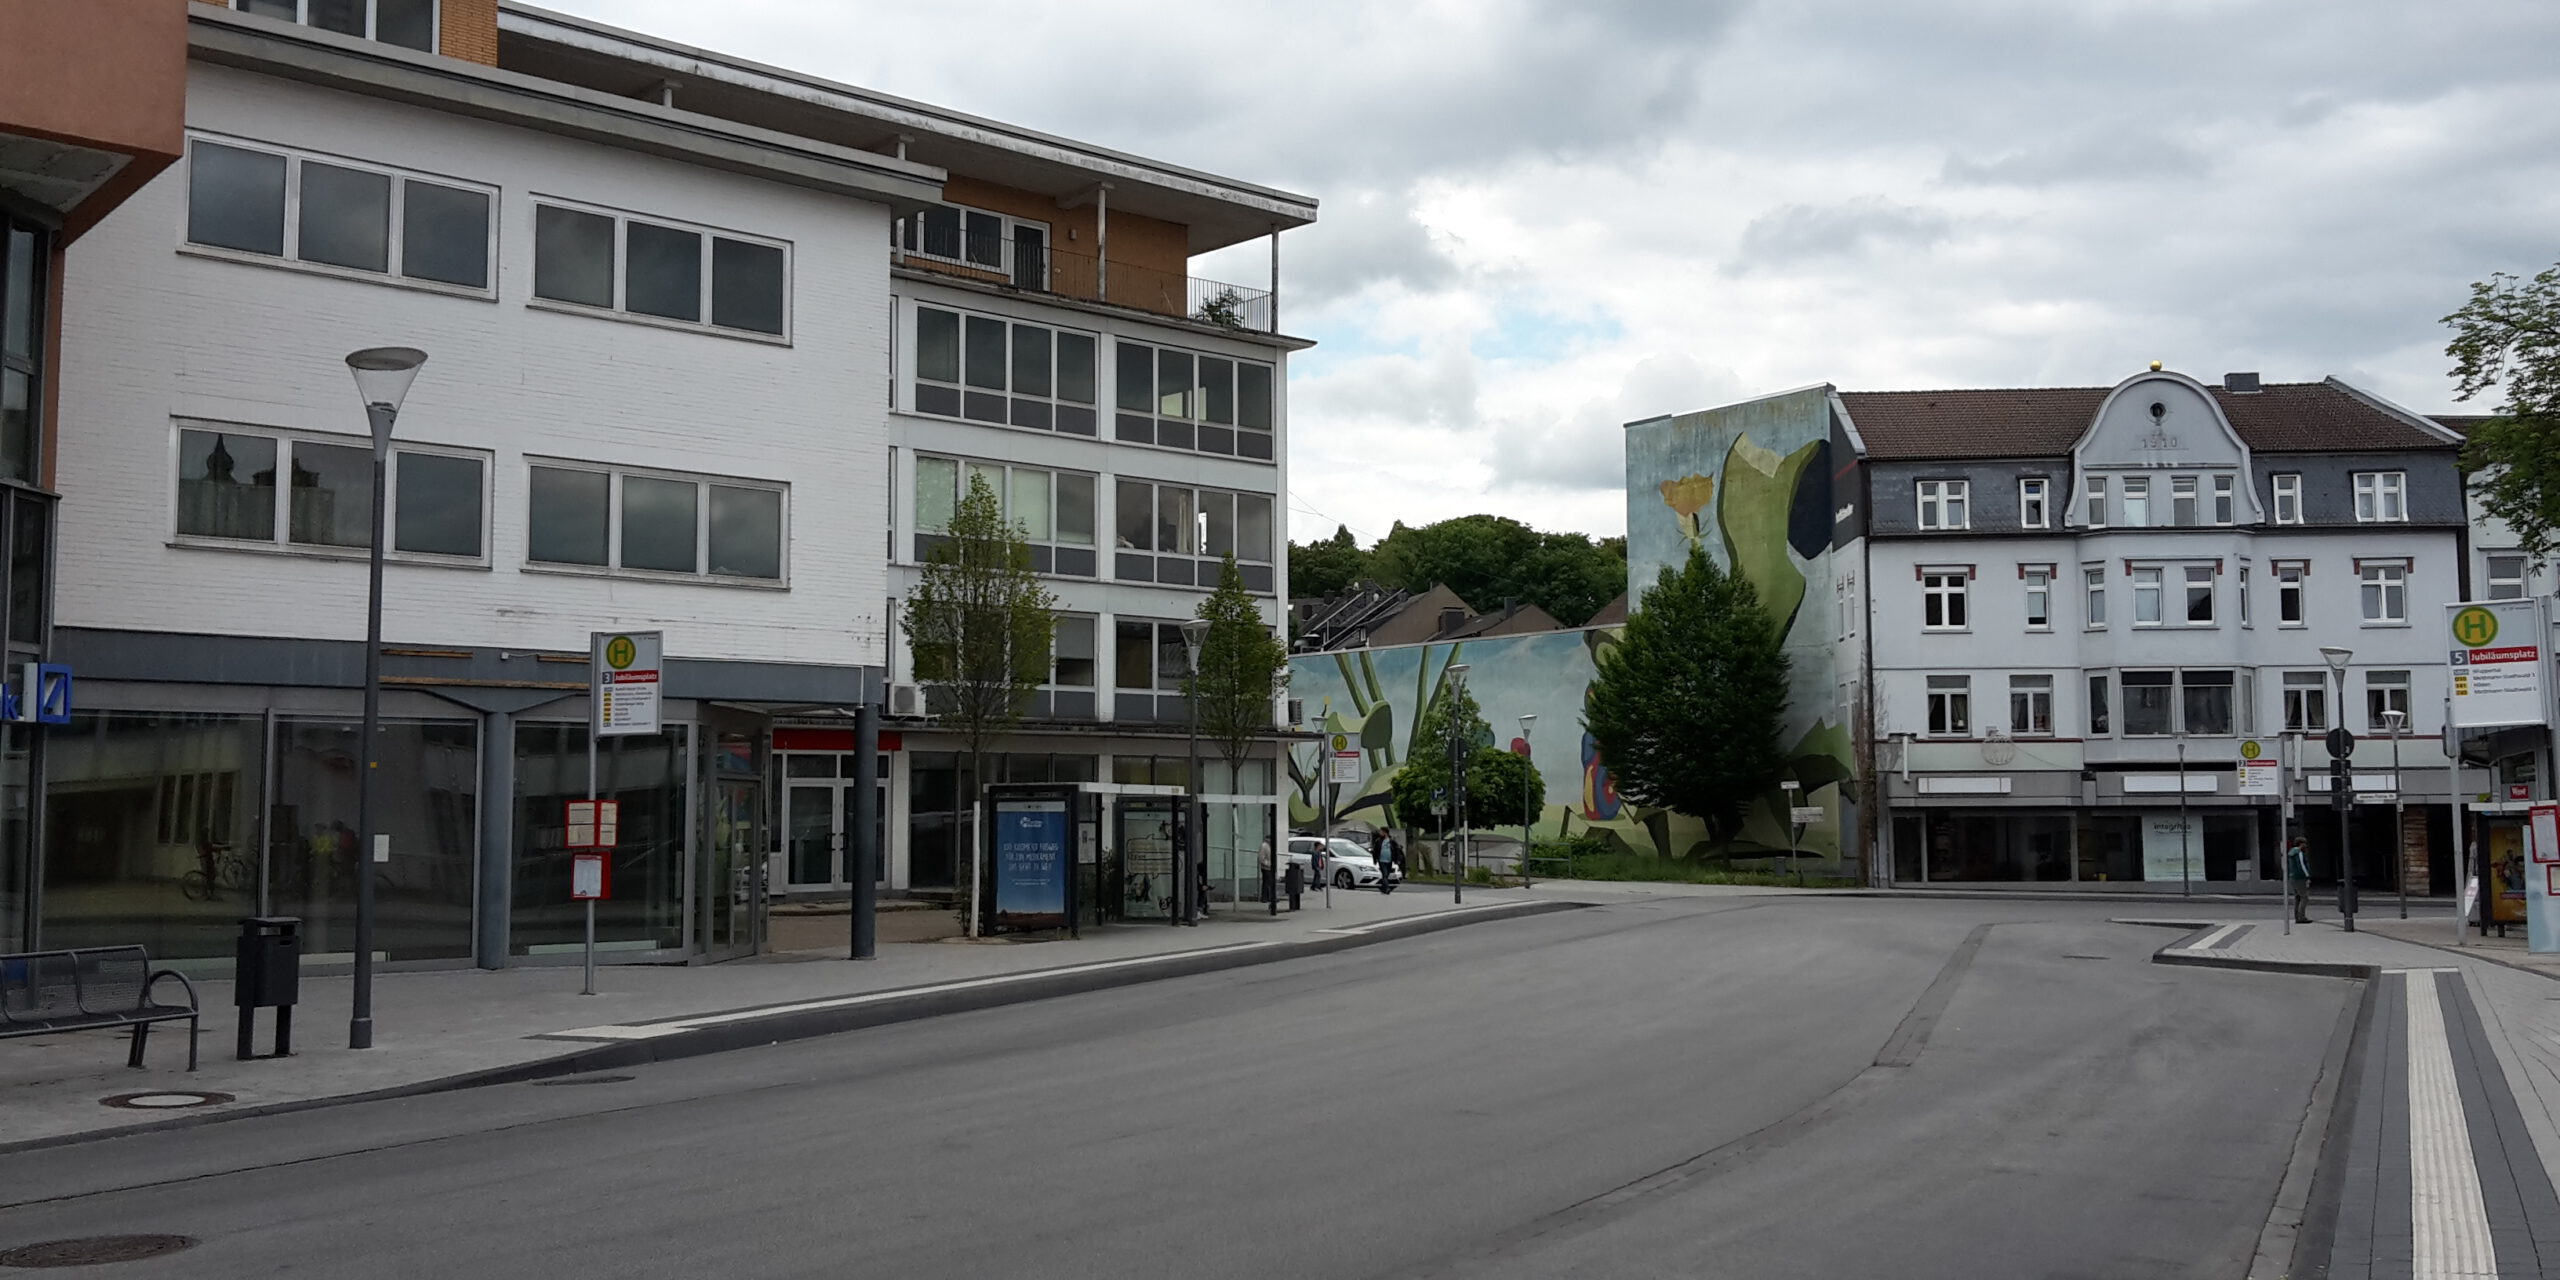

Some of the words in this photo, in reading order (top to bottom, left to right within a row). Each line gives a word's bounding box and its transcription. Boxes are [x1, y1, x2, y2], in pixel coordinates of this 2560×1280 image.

[2142, 437, 2178, 449] 1910
[2454, 652, 2464, 665] 5
[2471, 650, 2536, 661] Jubiläumsplatz
[604, 672, 611, 684] 3
